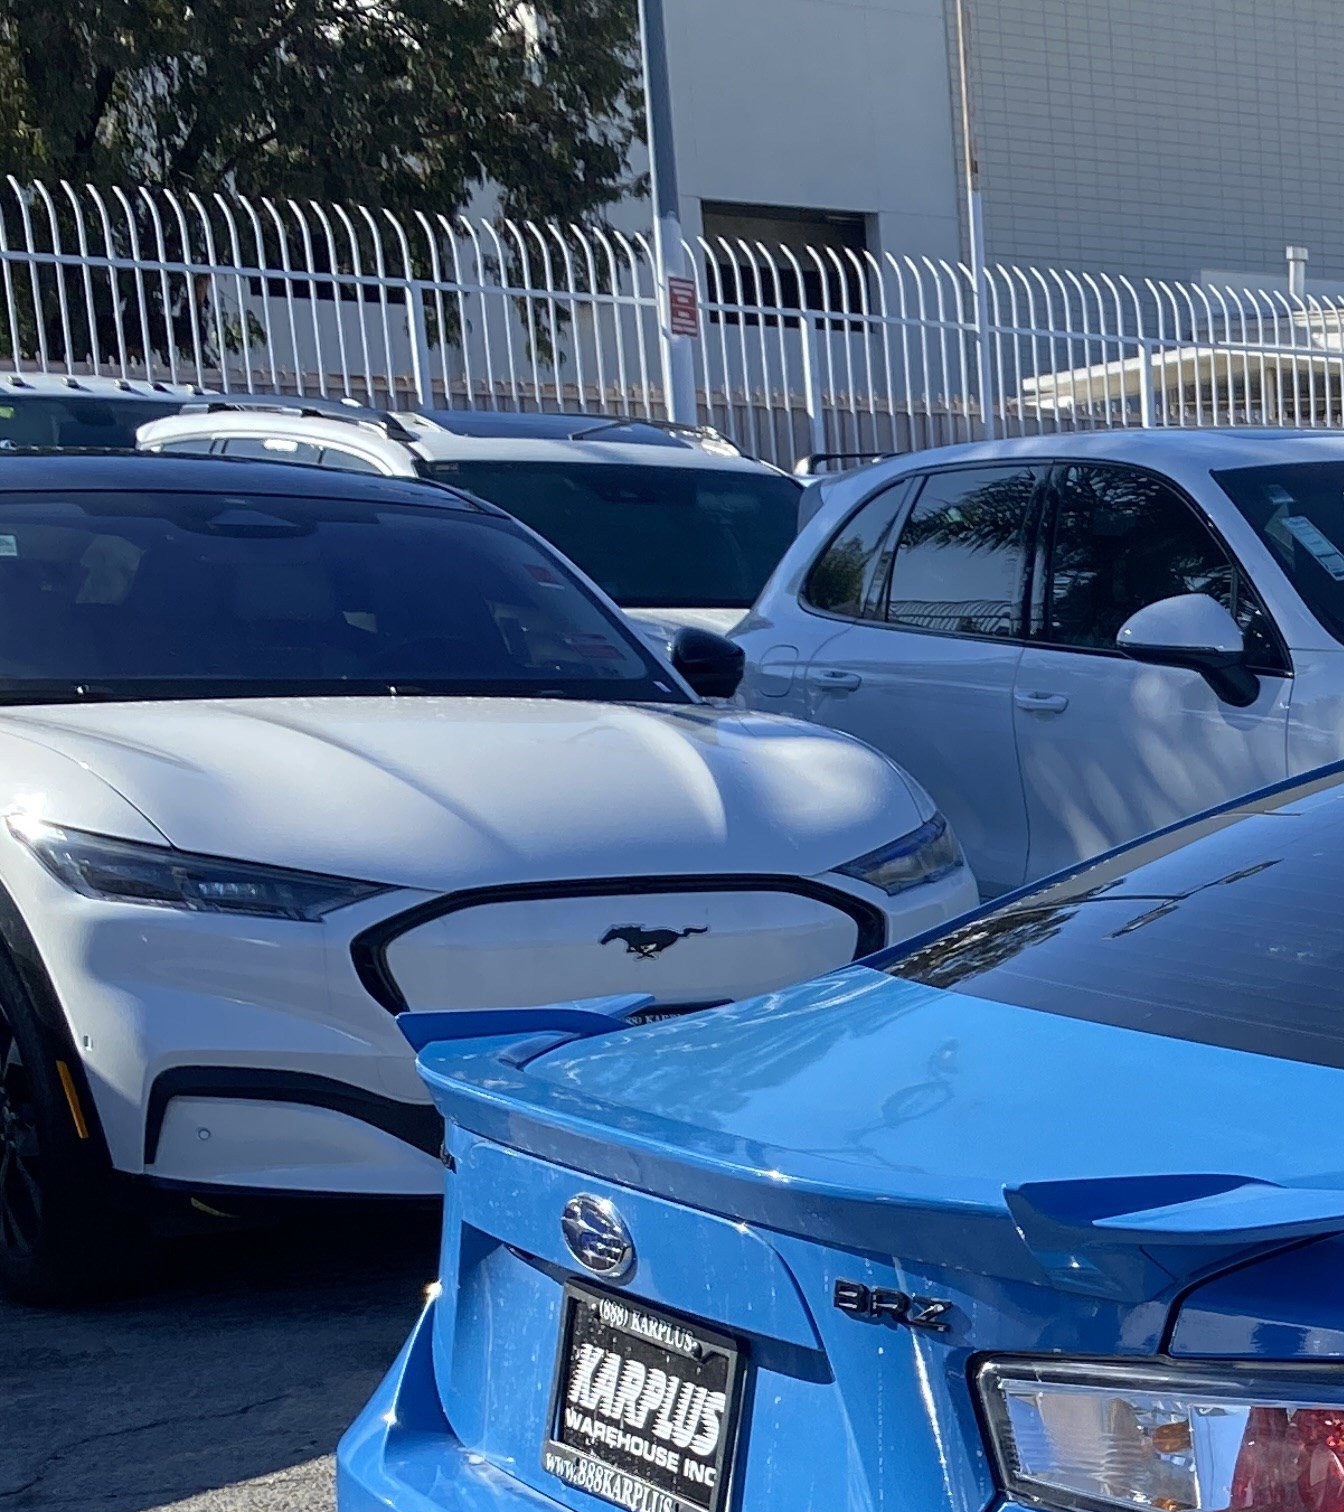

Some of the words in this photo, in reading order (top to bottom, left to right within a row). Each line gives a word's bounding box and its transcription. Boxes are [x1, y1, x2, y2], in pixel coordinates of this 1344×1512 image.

[600, 1299, 628, 1328] (888)
[631, 1312, 693, 1351] KARPLUS
[834, 1279, 952, 1333] BRZ
[567, 1343, 727, 1456] KARPLUS
[565, 1407, 680, 1474] WAREHOUSE
[683, 1458, 717, 1487] INC
